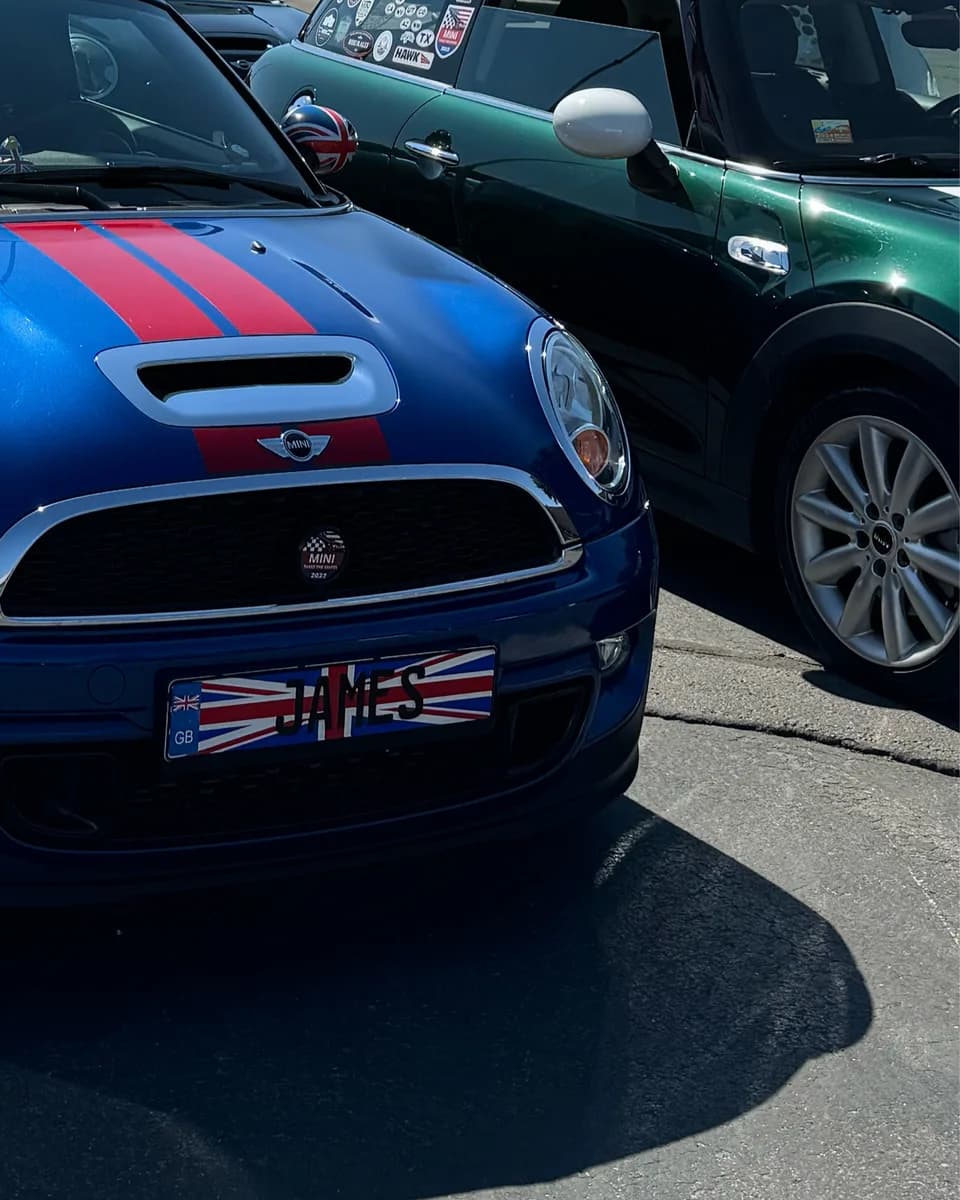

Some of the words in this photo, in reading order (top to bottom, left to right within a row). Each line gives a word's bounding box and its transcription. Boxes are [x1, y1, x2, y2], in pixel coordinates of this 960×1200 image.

[420, 34, 432, 46] TX
[394, 47, 421, 63] HAWK
[286, 439, 311, 450] MINI
[308, 553, 336, 564] MINI
[275, 665, 426, 735] JAMES
[174, 729, 194, 746] GB
